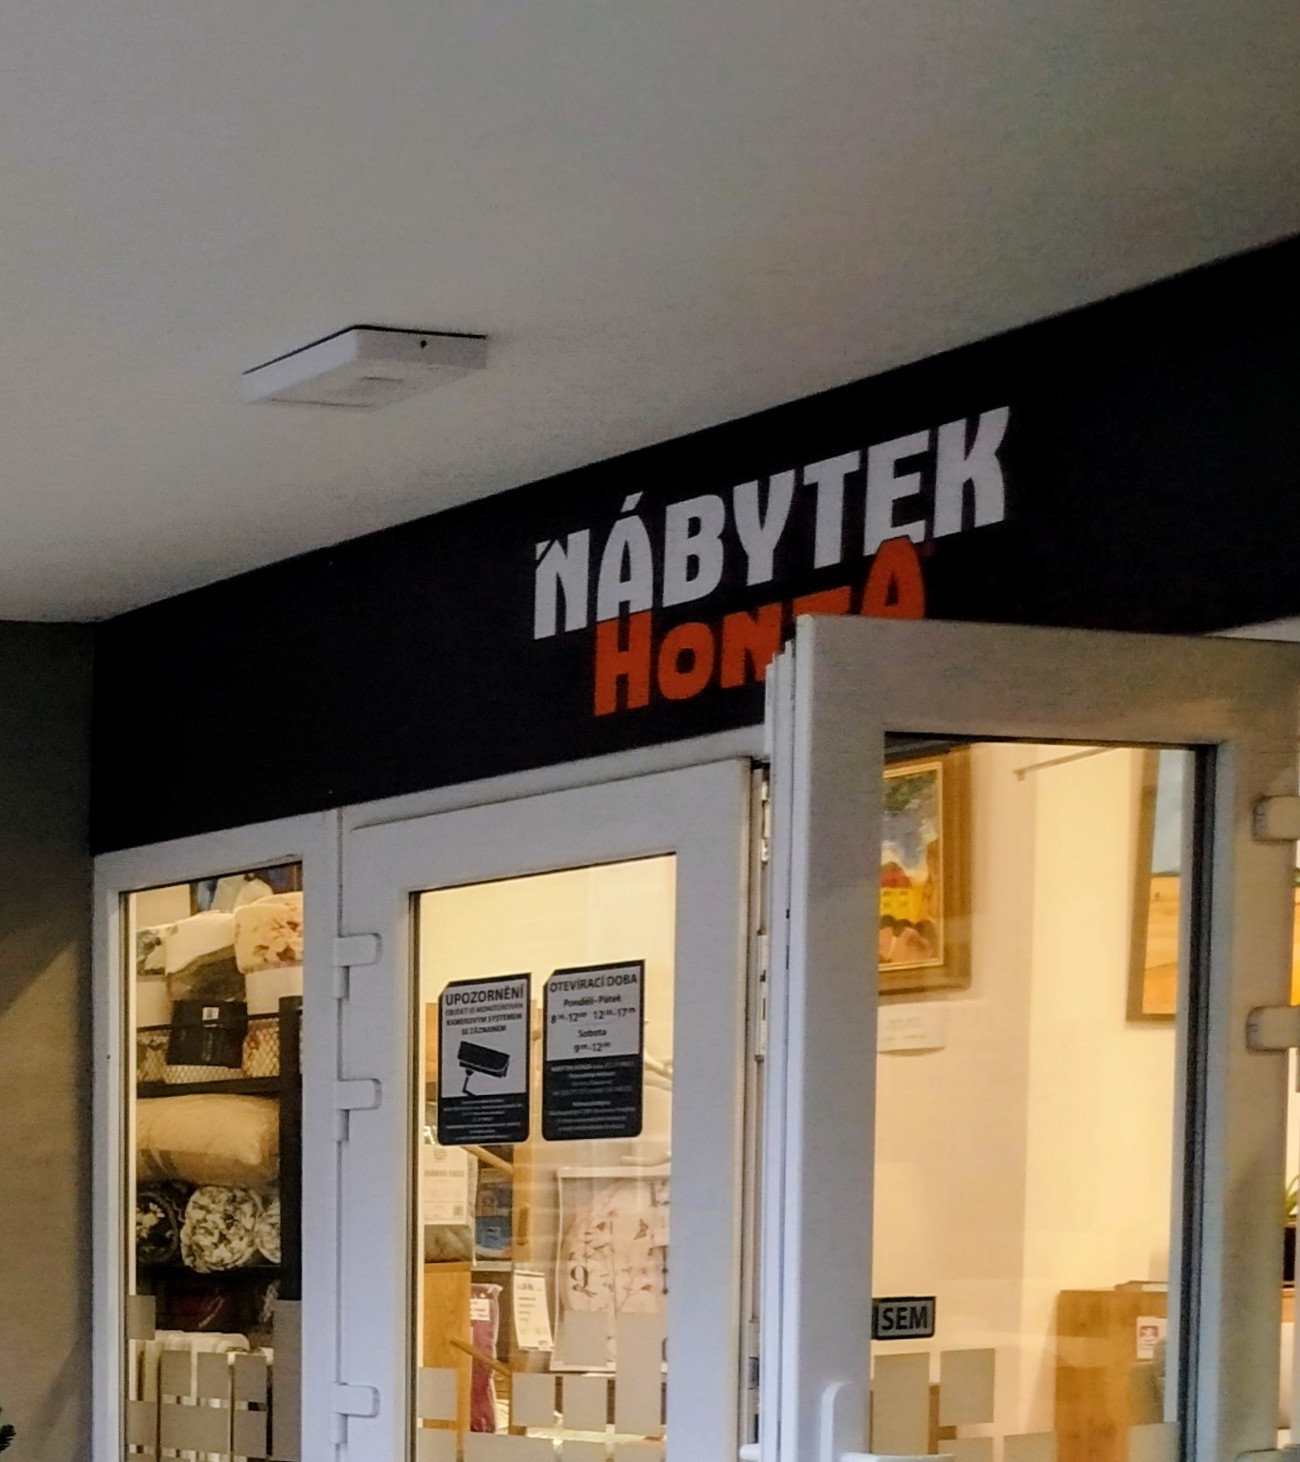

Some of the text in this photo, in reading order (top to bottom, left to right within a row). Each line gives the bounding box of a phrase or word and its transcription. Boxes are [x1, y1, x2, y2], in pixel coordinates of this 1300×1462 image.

[533, 406, 1011, 640] NÁBYTEK
[607, 973, 638, 987] DOBA
[445, 984, 525, 1006] UPOZORNĚNÍ
[882, 1306, 928, 1330] SEM
